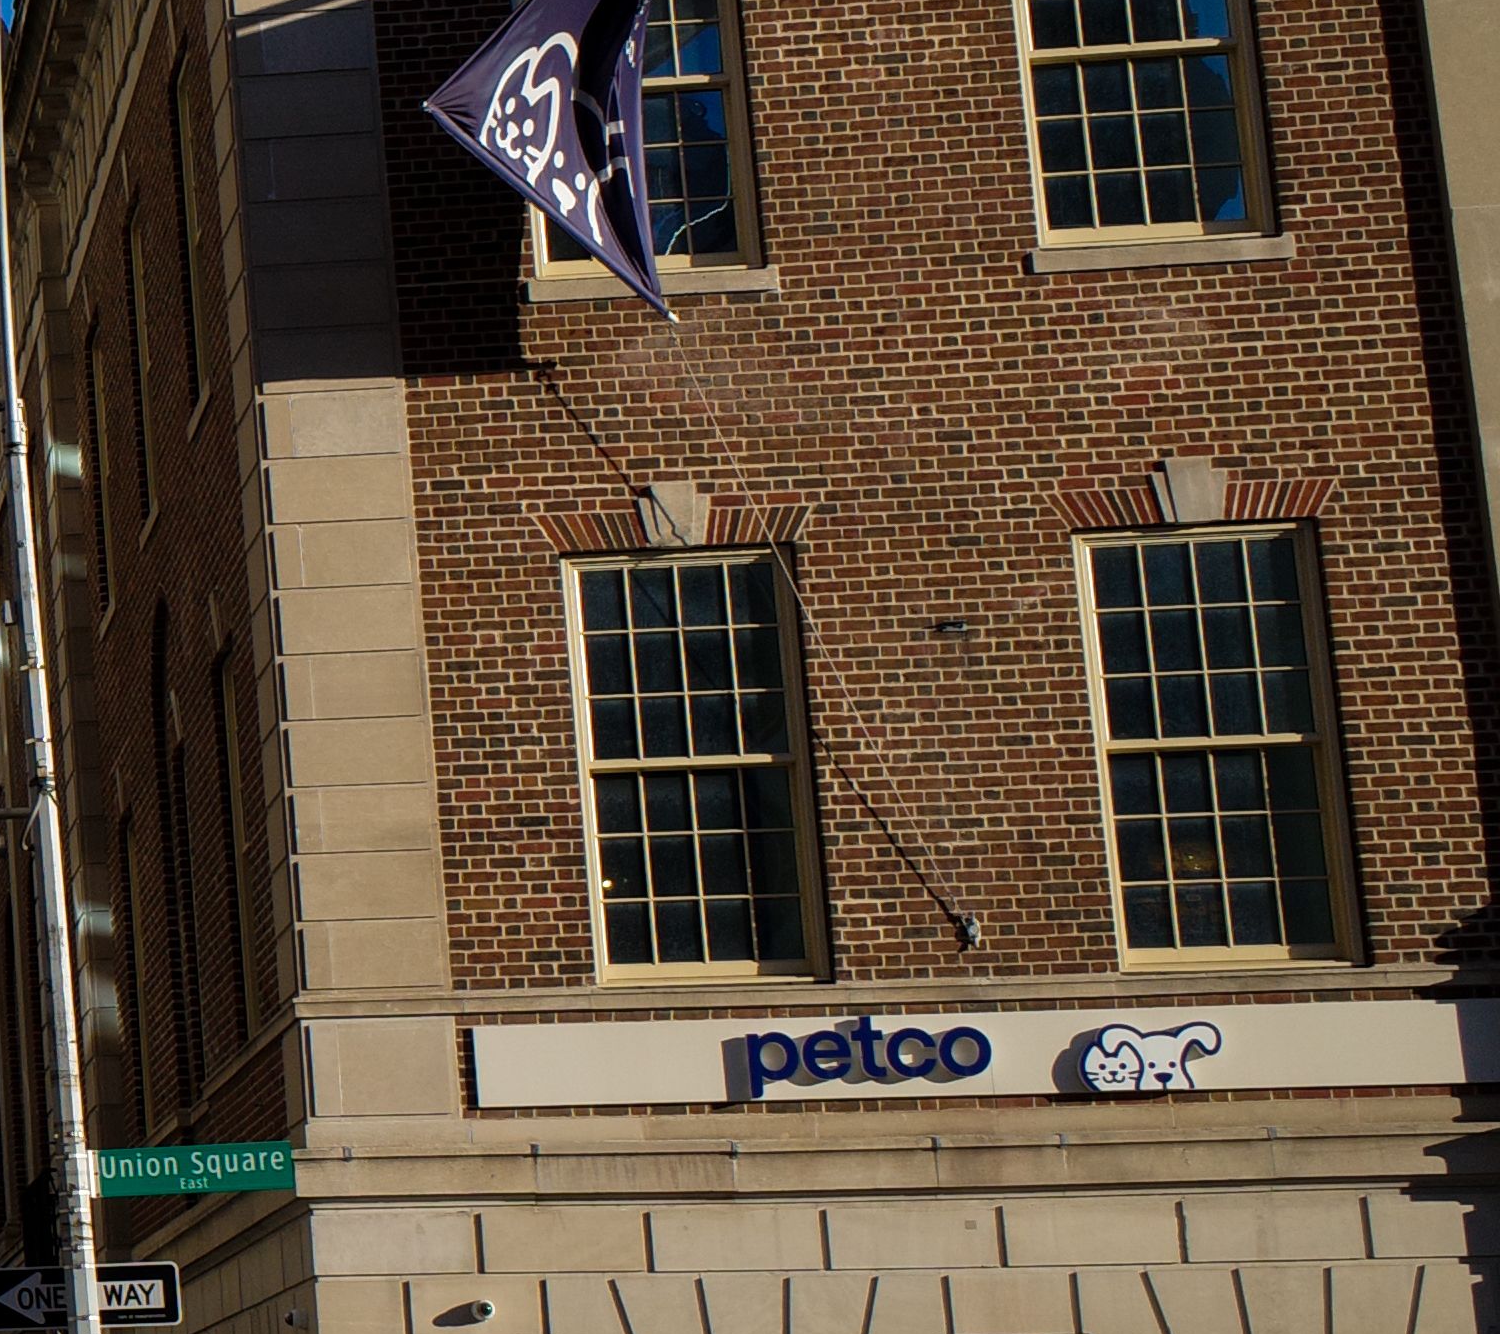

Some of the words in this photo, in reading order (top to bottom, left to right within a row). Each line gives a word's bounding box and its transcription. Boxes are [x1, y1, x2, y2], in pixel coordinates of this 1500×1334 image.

[744, 1015, 993, 1099] petco
[101, 1152, 178, 1179] Union
[190, 1150, 285, 1180] Square
[179, 1177, 210, 1190] East
[16, 1286, 67, 1310] ONE
[103, 1282, 155, 1307] WAY
